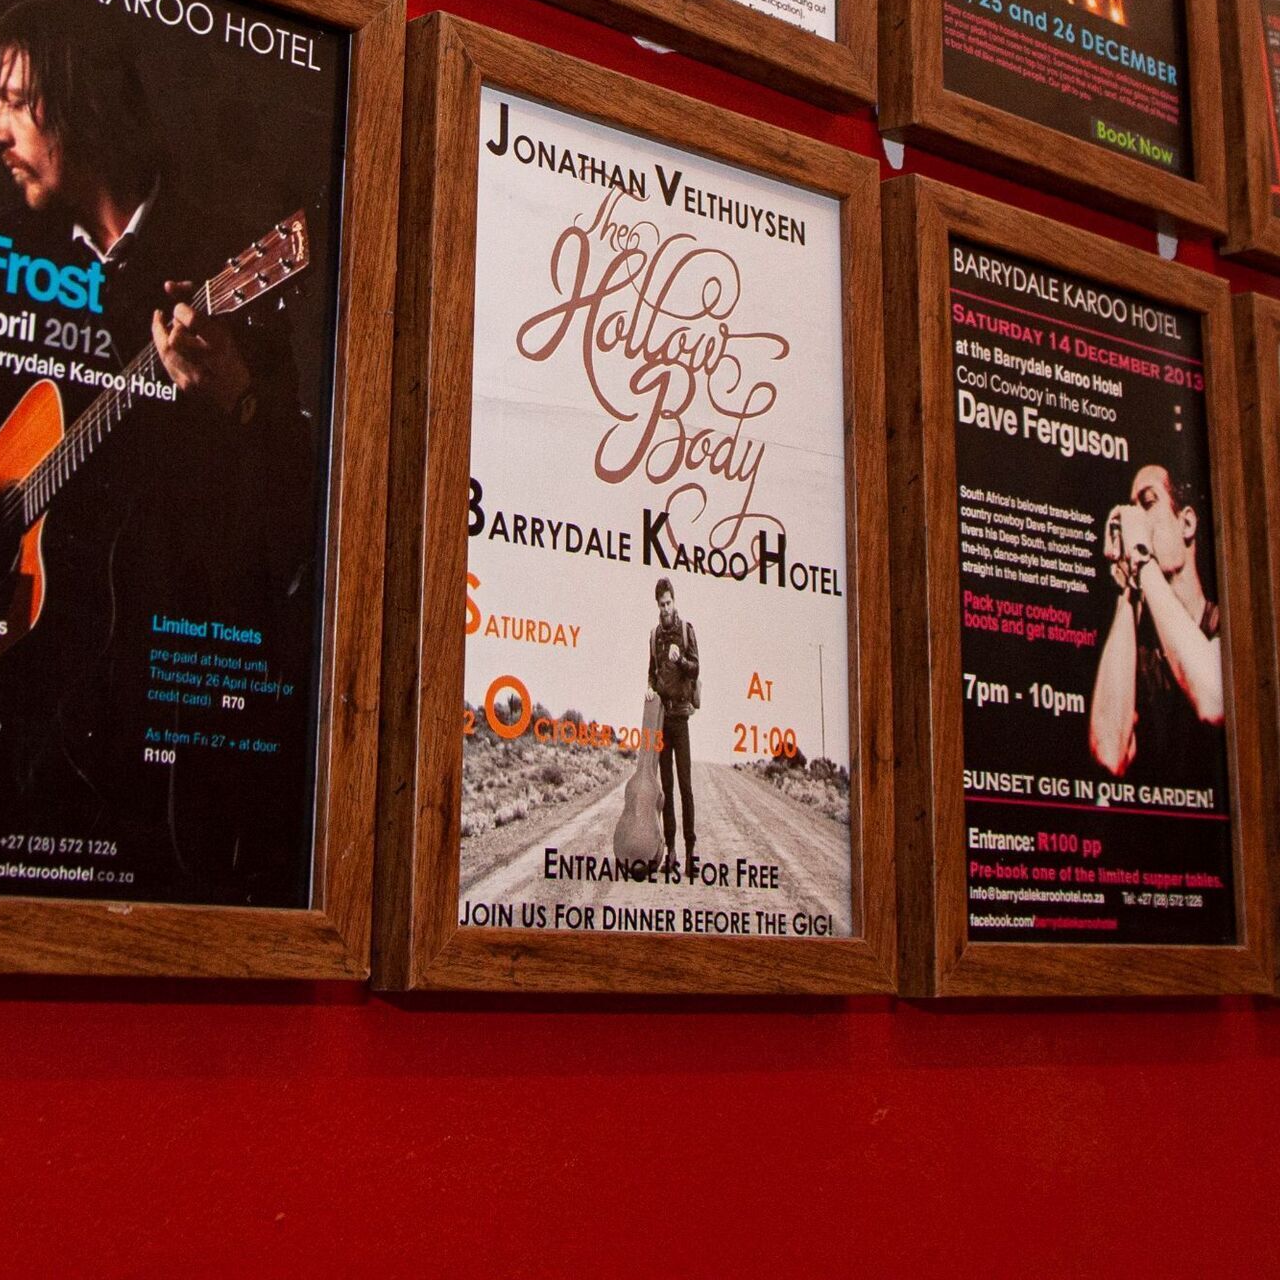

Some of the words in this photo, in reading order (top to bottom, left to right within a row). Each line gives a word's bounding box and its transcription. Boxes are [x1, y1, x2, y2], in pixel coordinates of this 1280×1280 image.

[224, 13, 322, 72] HOTEL
[1009, 3, 1047, 32] and
[1053, 18, 1075, 43] 26
[1081, 30, 1178, 86] DECEMBER
[1096, 121, 1136, 150] Book
[1139, 137, 1173, 164] Now
[486, 103, 646, 199] JONATHAN
[655, 164, 806, 246] VELTHUYSEN
[953, 248, 1058, 303] BARRYDALE
[1063, 284, 1127, 323] KAROO
[1132, 304, 1181, 340] HOTEL
[44, 320, 112, 358] 2012
[952, 304, 1042, 345] SATURDAY
[1049, 332, 1071, 353] 14
[1075, 340, 1160, 379] DECEMBER
[1164, 368, 1204, 391] 2013
[69, 362, 126, 391] Karoo
[130, 373, 177, 401] Hotel
[957, 366, 988, 388] Cool
[990, 375, 1043, 407] Cowboy
[1046, 387, 1057, 405] in
[1059, 391, 1079, 412] the
[1082, 399, 1117, 422] Karoo
[958, 390, 1018, 436] Dave
[1023, 407, 1128, 462] Ferguson
[467, 477, 631, 562] BARRYDALE
[642, 508, 749, 580] KAROO
[759, 531, 843, 596] HOTEL
[152, 614, 208, 640] Limited
[213, 622, 262, 646] Tickets
[466, 571, 581, 648] SATURDAY
[484, 675, 612, 748] OCTOBER
[619, 727, 664, 753] 2013
[747, 672, 773, 702] AT
[733, 723, 797, 758] 21:00
[962, 770, 1033, 794] SUNSET
[1038, 775, 1070, 796] GIG
[1075, 780, 1093, 799] IN
[1098, 782, 1136, 803] OUR
[1139, 787, 1215, 808] GARDEN!
[544, 847, 657, 884] ENTRANCE
[664, 855, 681, 885] IS
[689, 856, 729, 887] FOR
[736, 858, 779, 889] FREE
[460, 900, 513, 927] JOIN
[522, 903, 547, 929] US
[554, 904, 594, 930] FOR
[602, 905, 675, 933] DINNER
[682, 907, 750, 934] BEFORE
[755, 910, 786, 935] THE
[792, 912, 833, 937] GIG!
